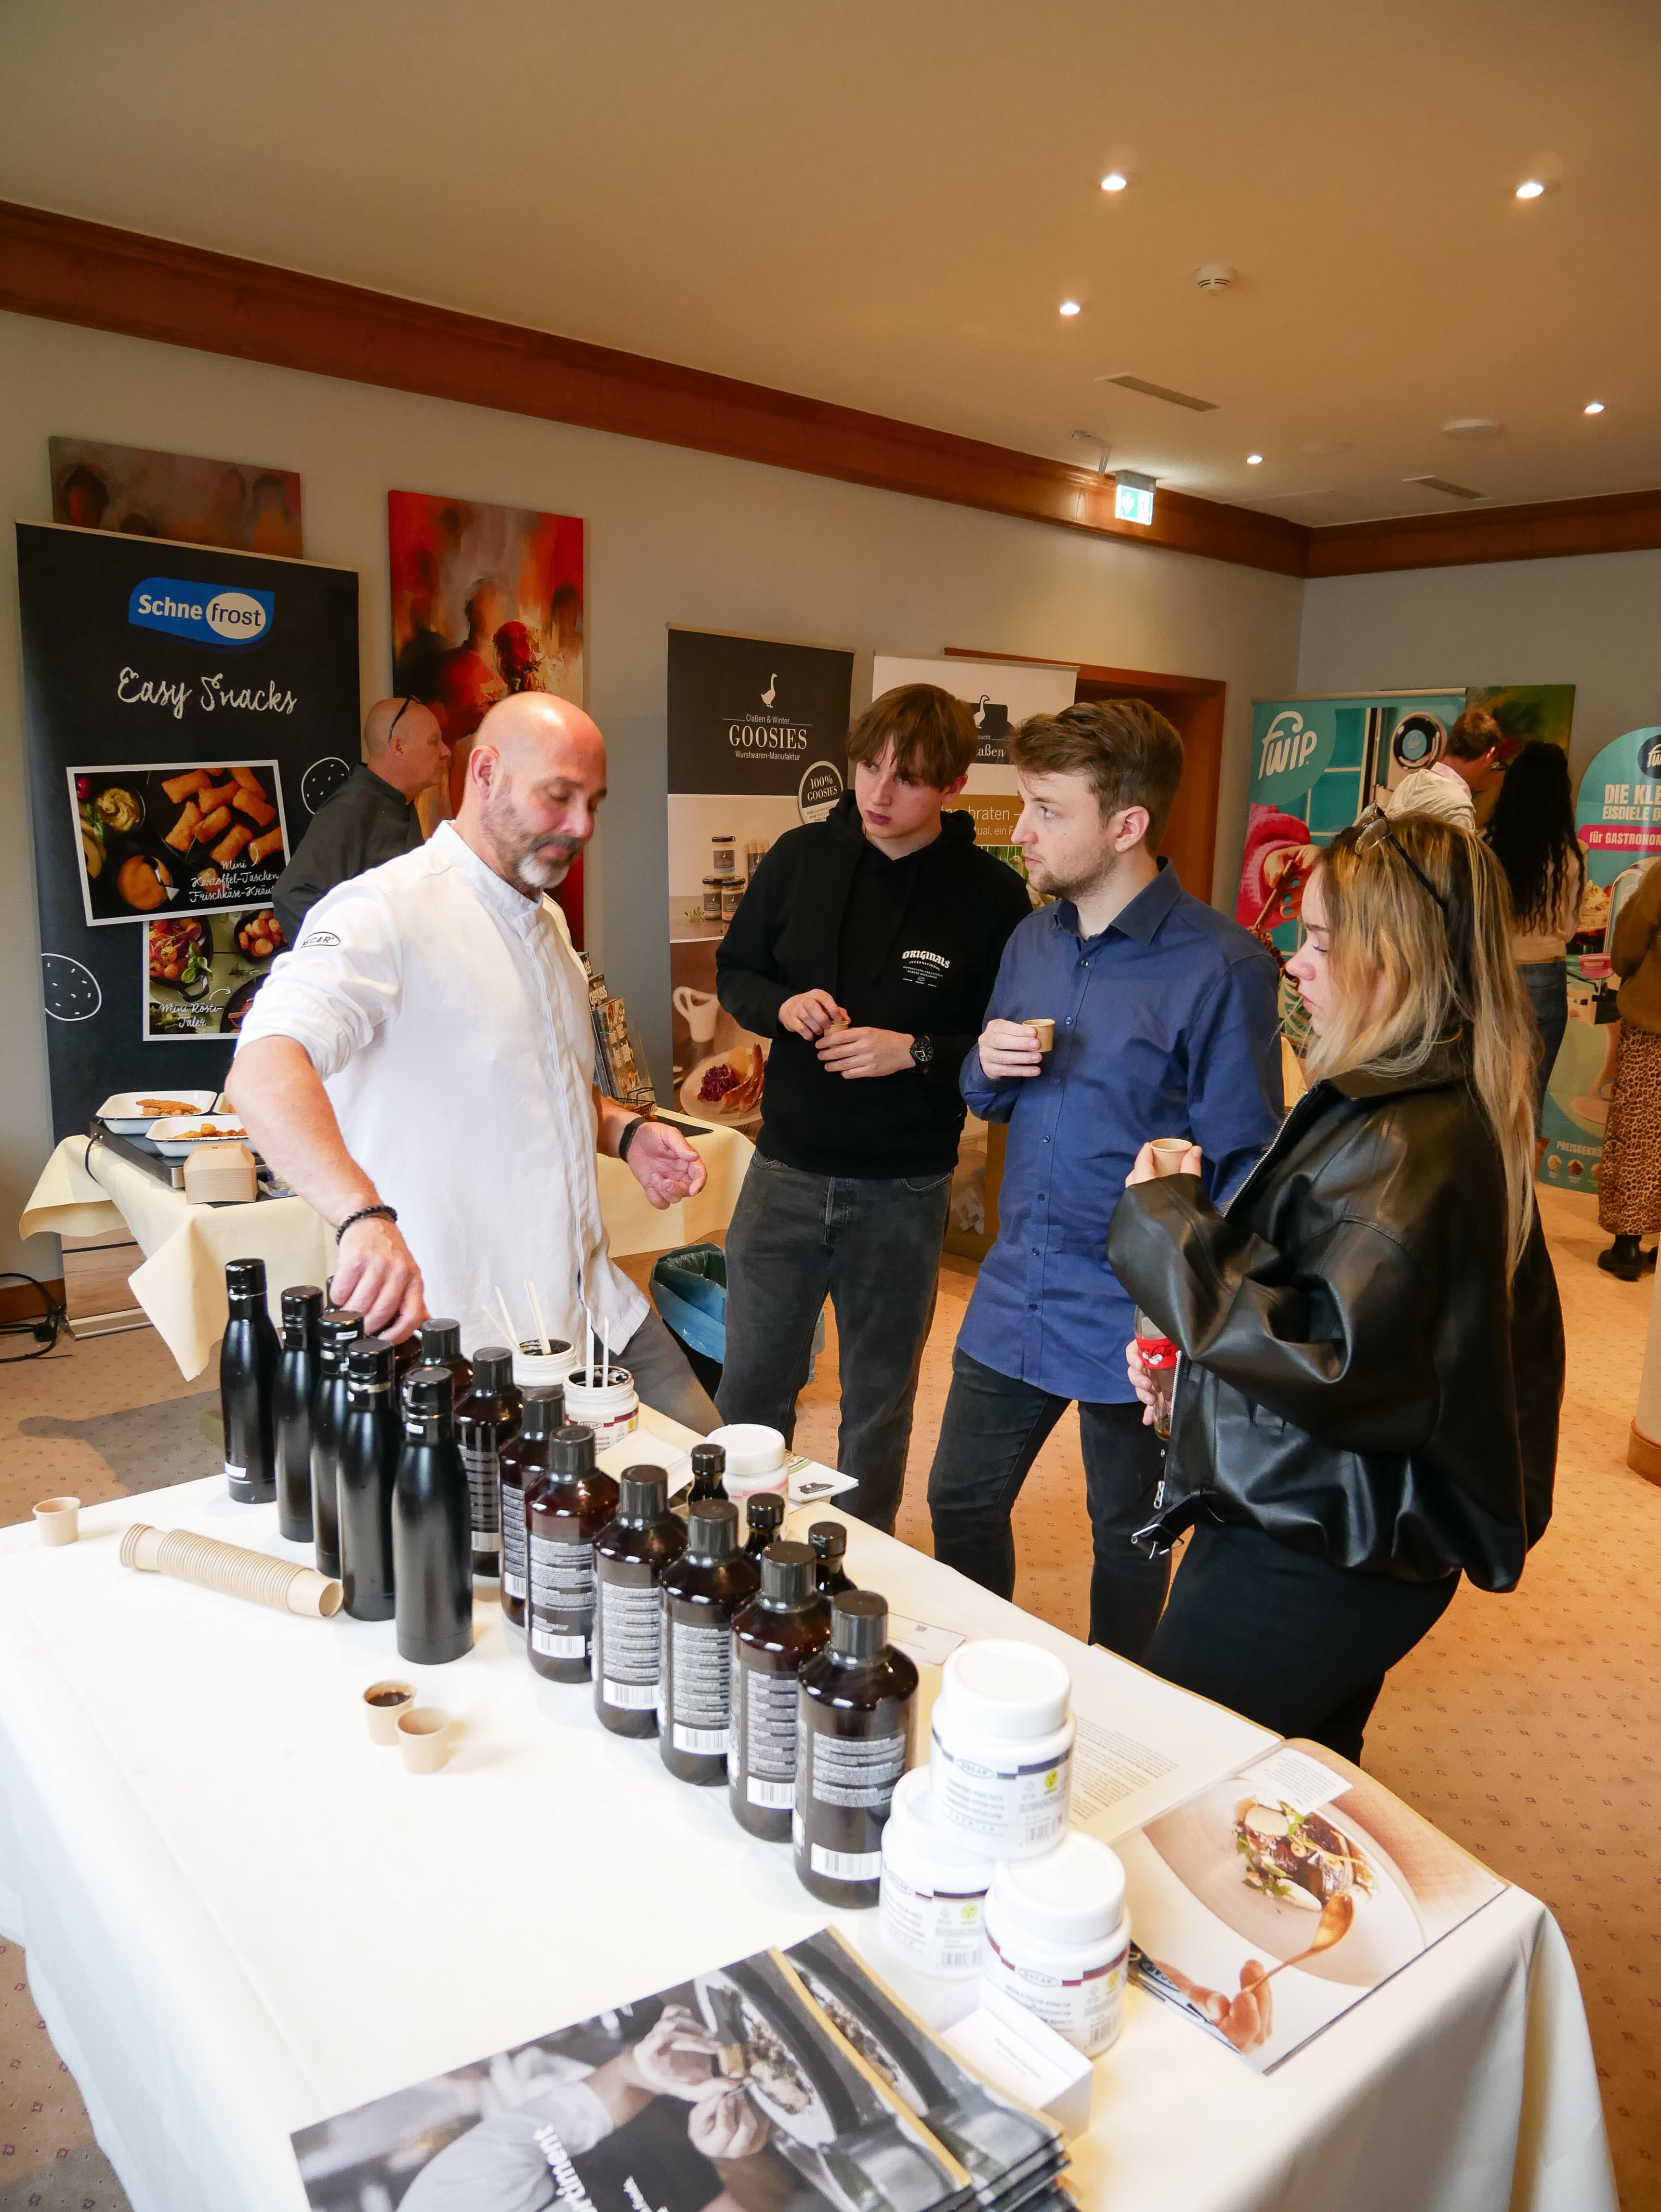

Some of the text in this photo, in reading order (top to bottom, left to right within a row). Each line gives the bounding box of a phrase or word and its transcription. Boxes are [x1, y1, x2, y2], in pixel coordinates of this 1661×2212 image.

[138, 594, 261, 626] Schne frost
[118, 666, 298, 719] Easy Snacks
[746, 713, 765, 723] Claßen
[772, 716, 790, 725] Winter
[729, 724, 807, 750] GOOSIES
[735, 750, 801, 761] Wurstwaren-Manufaktur
[976, 744, 1004, 757] aßen
[1647, 743, 1661, 768] fw
[809, 775, 833, 789] 100%
[807, 785, 838, 801] GOOSIES
[1604, 784, 1661, 805] DIE KLE
[1602, 805, 1661, 821] EISDIELE D
[974, 826, 1014, 836] tual, ein F
[1589, 830, 1603, 843] für
[220, 860, 247, 870] Mini
[189, 885, 274, 903] Frischkäse-Kräu
[901, 949, 950, 969] ORIGINALS
[589, 985, 608, 1010] genuss
[160, 1002, 188, 1014] Mini
[532, 2123, 597, 2212] rtiment
